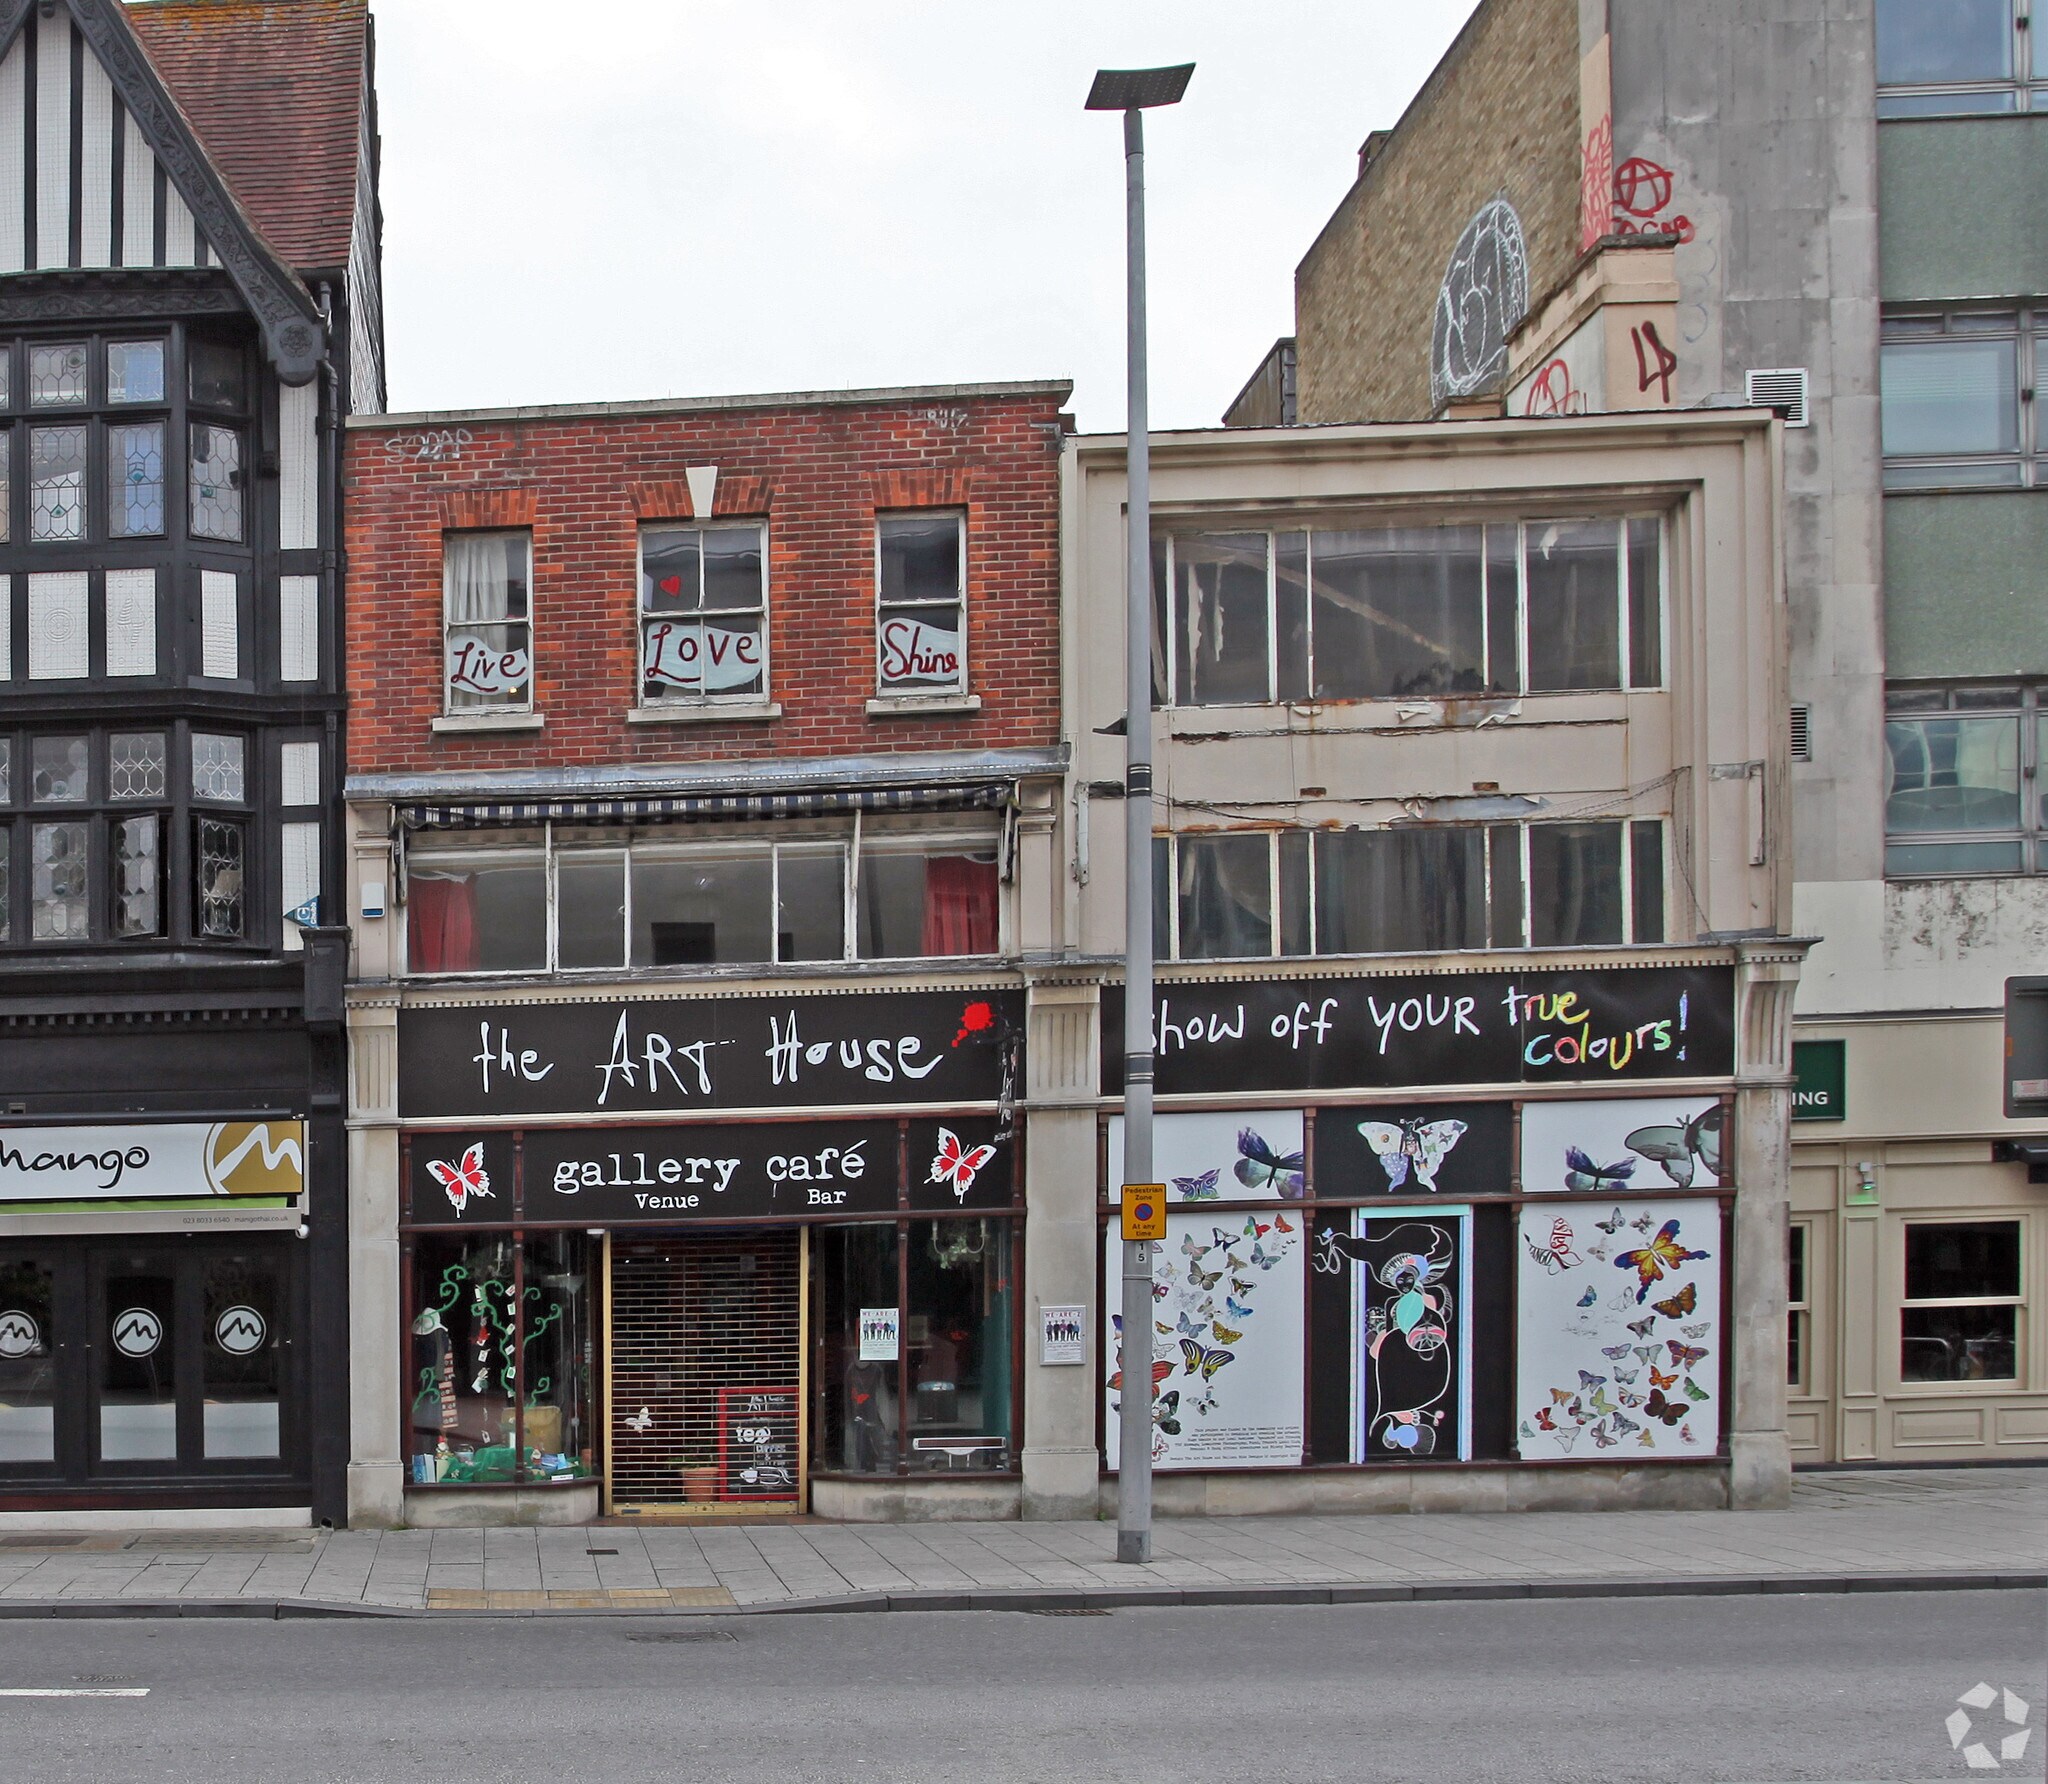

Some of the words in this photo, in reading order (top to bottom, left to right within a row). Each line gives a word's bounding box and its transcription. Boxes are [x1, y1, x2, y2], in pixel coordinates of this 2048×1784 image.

[450, 642, 526, 692] Live
[646, 622, 760, 683] Love
[883, 622, 959, 678] Shine
[1152, 1000, 1244, 1055] how
[1271, 998, 1339, 1050] off
[1368, 994, 1480, 1055] YOUR
[1501, 986, 1590, 1027] true
[1524, 989, 1688, 1070] colours!
[473, 1021, 555, 1094] the
[595, 1008, 722, 1104] ART
[765, 1009, 944, 1085] House
[552, 1153, 741, 1194] gallery
[766, 1139, 868, 1184] café
[1124, 1186, 1163, 1194] Pedestrian
[634, 1192, 700, 1210] Venue
[807, 1188, 847, 1206] Bar
[1139, 1242, 1144, 1251] 1
[1143, 1223, 1156, 1231] any
[1138, 1253, 1145, 1262] 5
